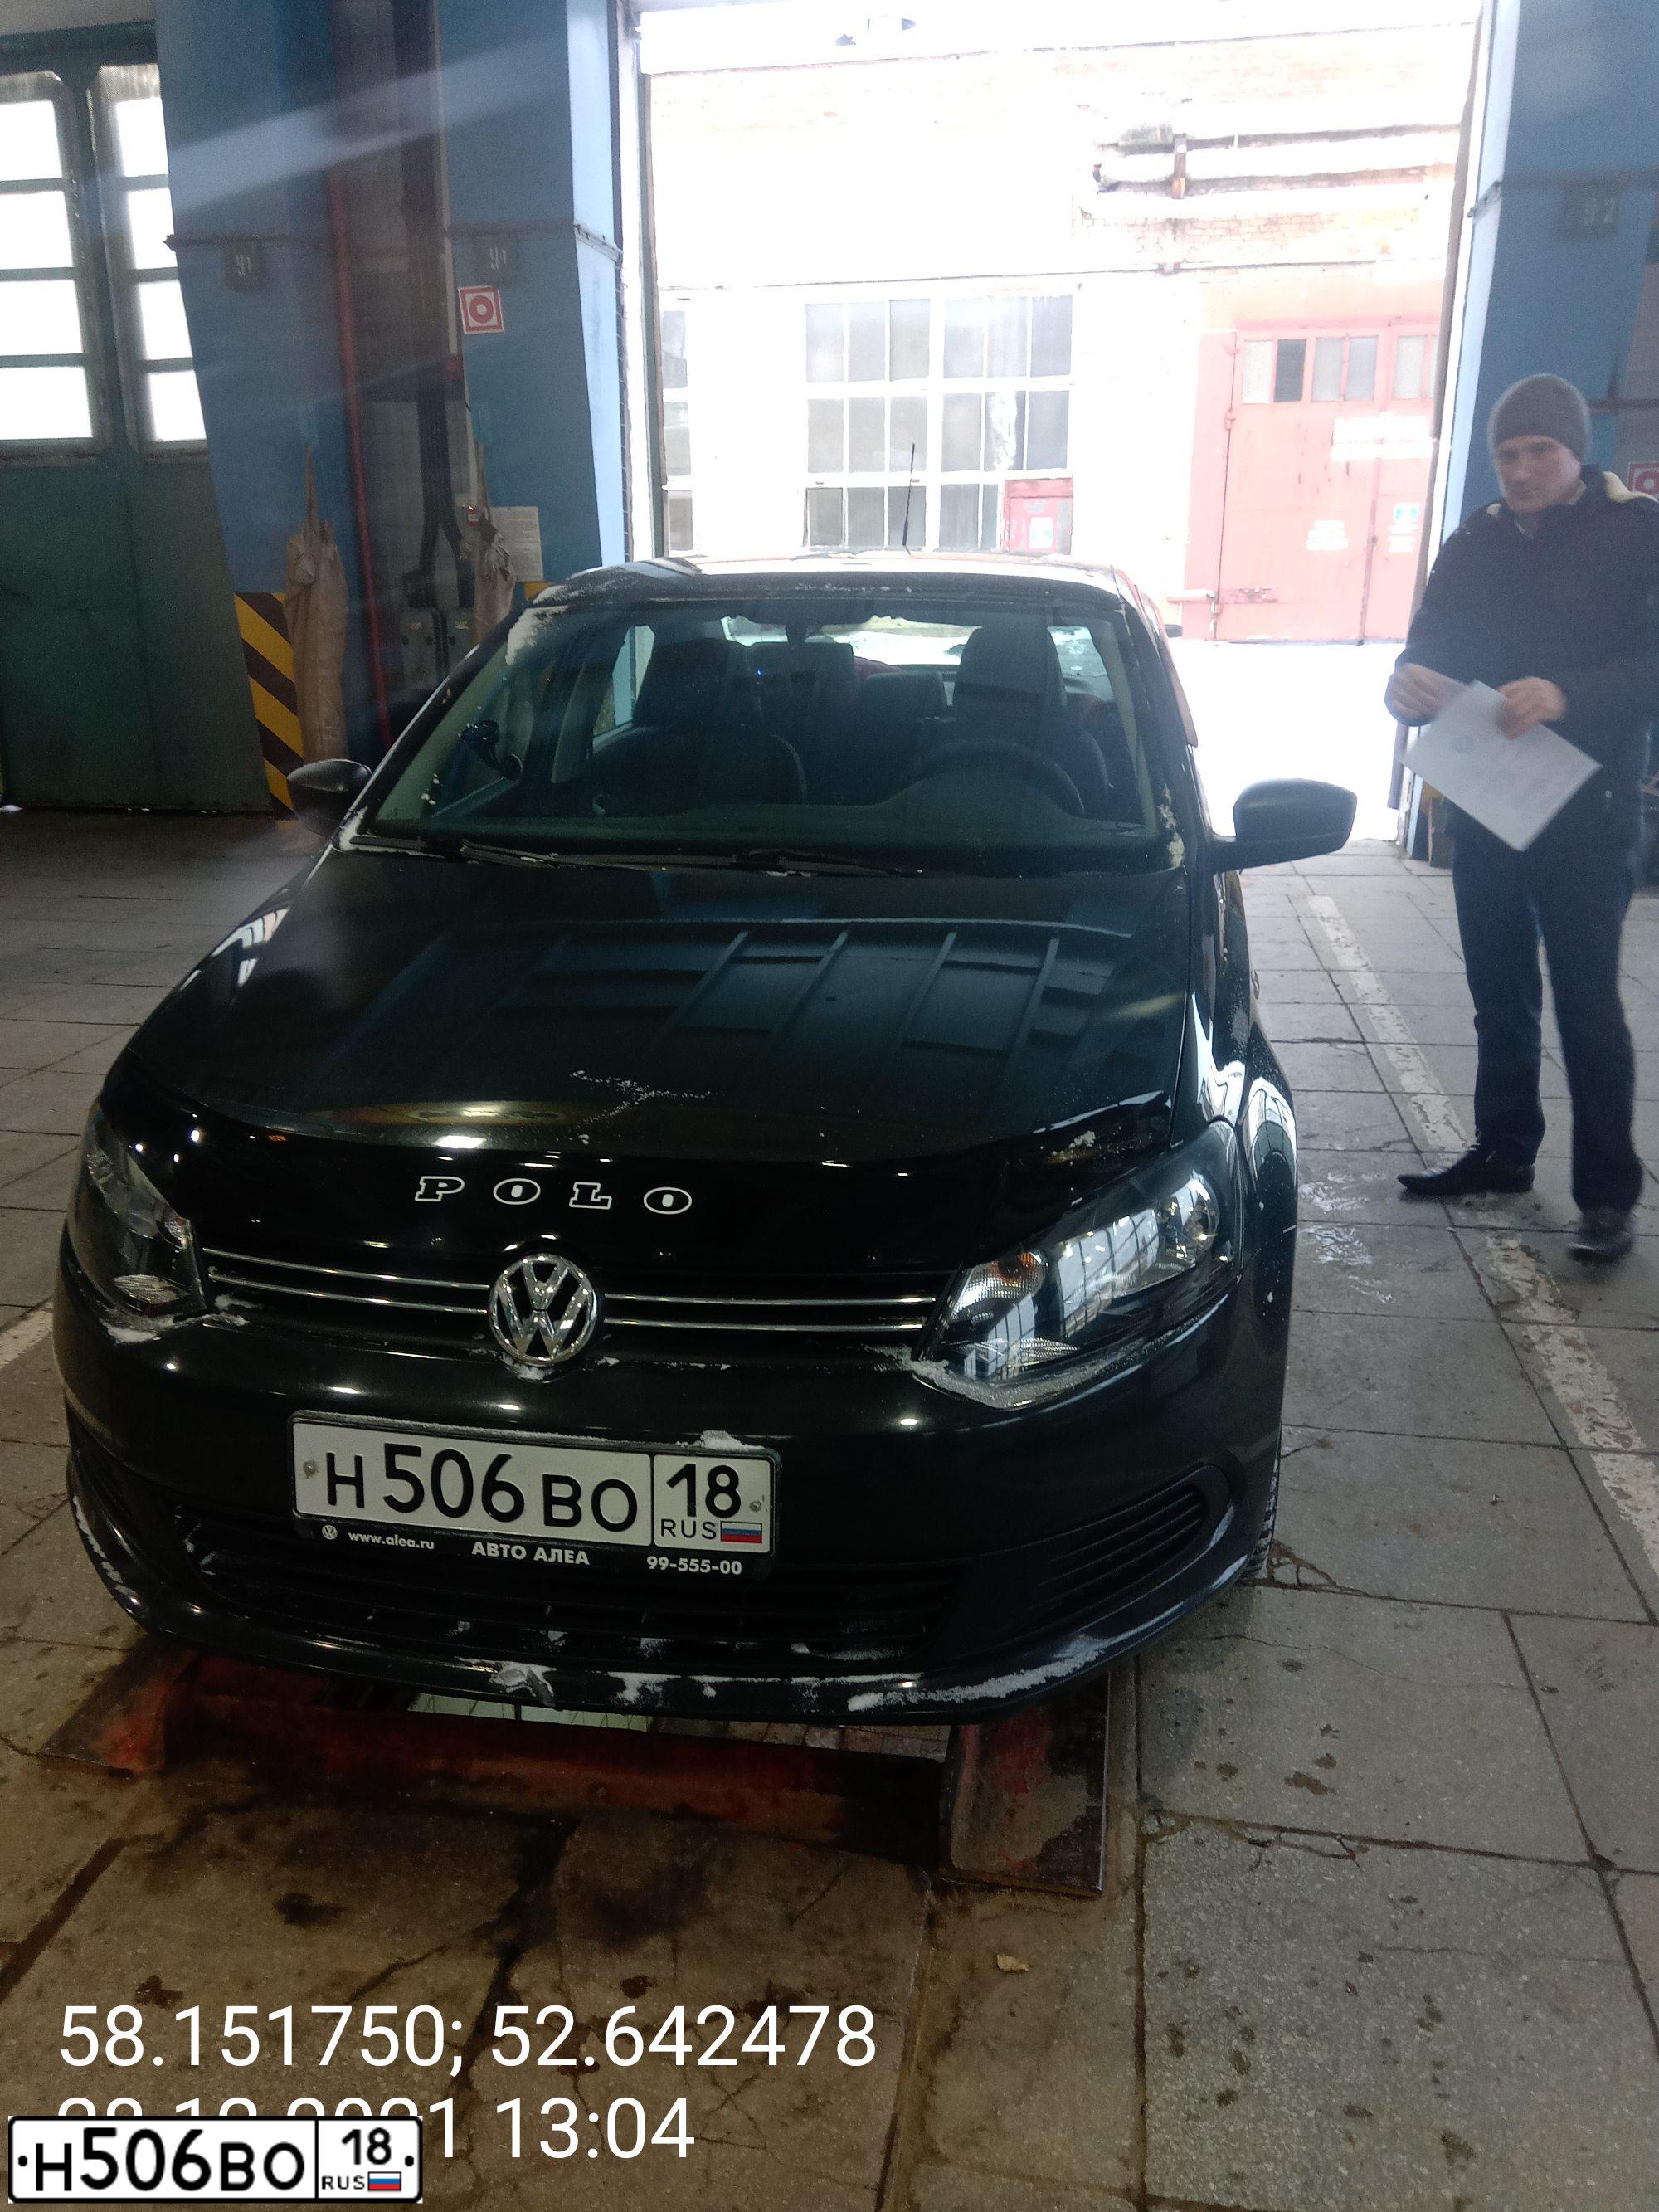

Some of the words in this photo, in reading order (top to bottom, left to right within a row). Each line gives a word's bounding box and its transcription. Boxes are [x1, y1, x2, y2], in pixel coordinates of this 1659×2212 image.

[415, 1175, 693, 1215] POLO
[326, 1443, 638, 1532] Н506ВО
[666, 1463, 742, 1518] 18
[660, 1518, 718, 1540] RUS
[348, 1532, 435, 1550] www.alea.ru
[472, 1542, 527, 1560] АВТО
[533, 1547, 590, 1566] АЛЕА
[646, 1556, 742, 1576] 99-555-00
